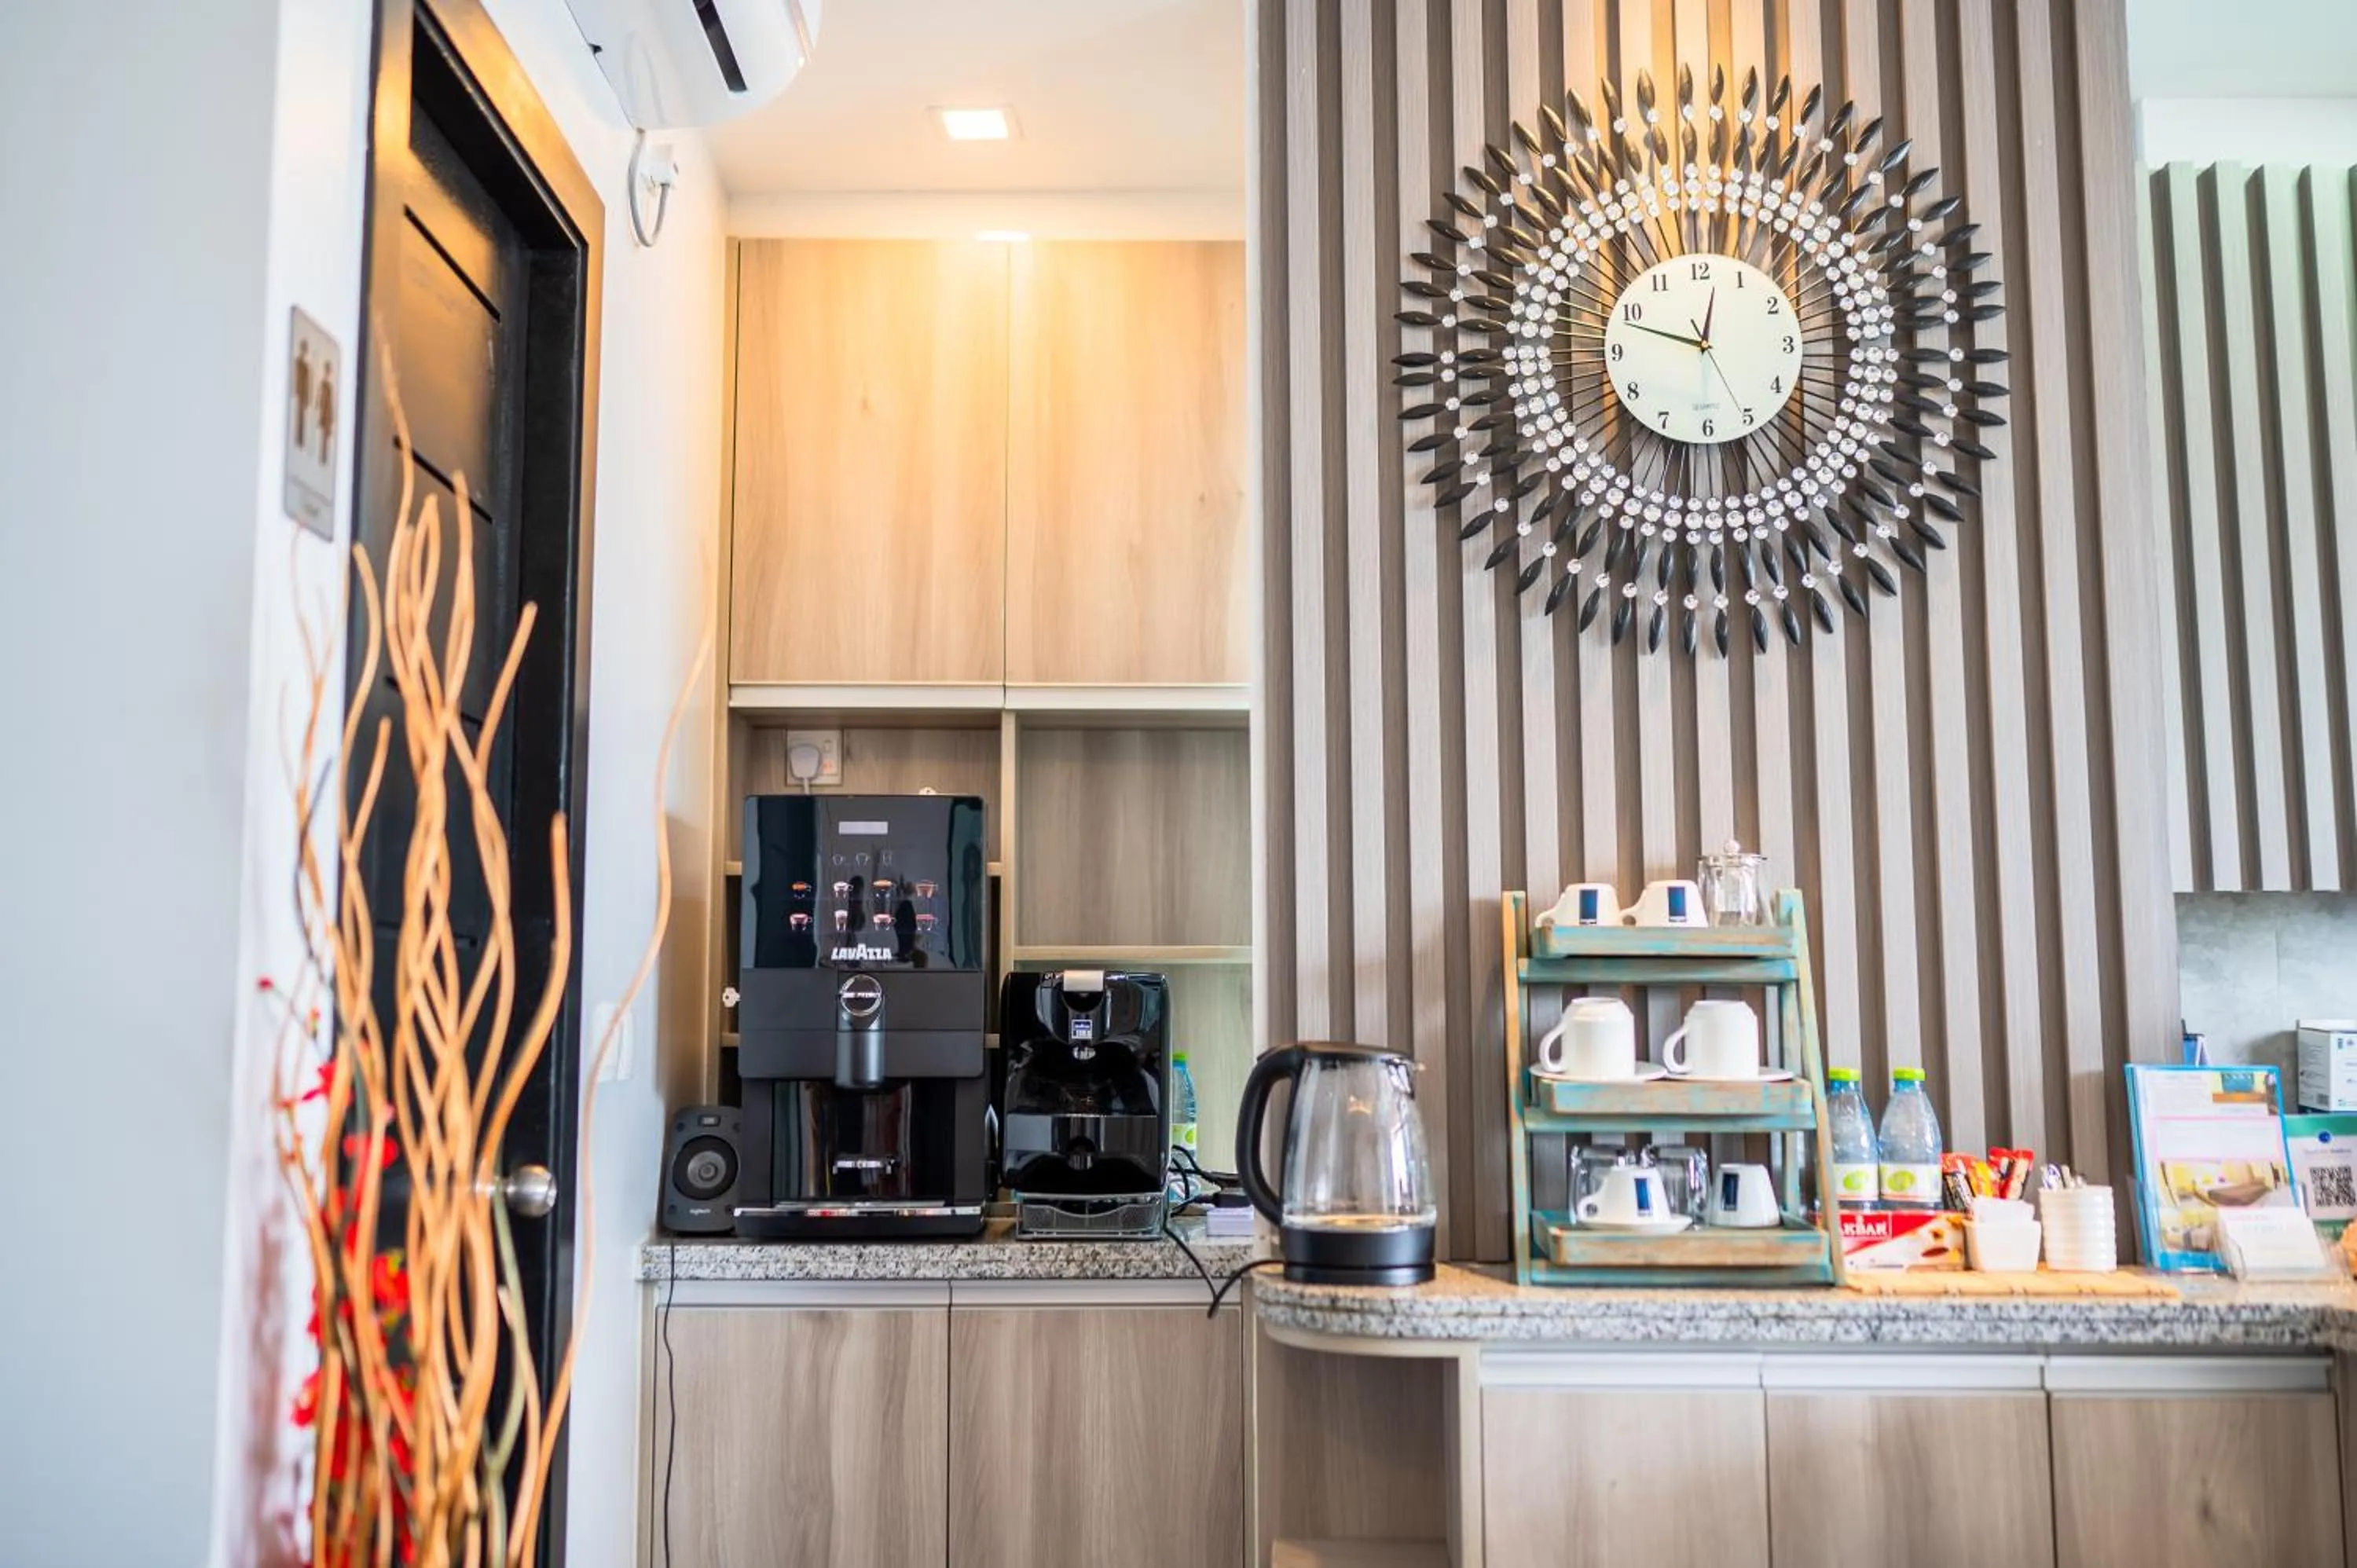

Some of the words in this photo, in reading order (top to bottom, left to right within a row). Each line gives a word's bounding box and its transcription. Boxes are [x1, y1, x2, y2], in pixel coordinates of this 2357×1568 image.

[1692, 262, 1710, 280] 12
[1737, 271, 1744, 288] 1
[1651, 273, 1669, 292] 11
[1623, 303, 1642, 321] 10
[1767, 296, 1780, 315] 2
[1611, 343, 1624, 361] 9
[1783, 335, 1795, 354] 3
[1626, 381, 1640, 401] 8
[1770, 375, 1782, 394] 4
[1658, 411, 1670, 430] 7
[1743, 408, 1754, 426] 5
[1702, 419, 1714, 437] 6
[830, 943, 893, 961] LAVAZZA
